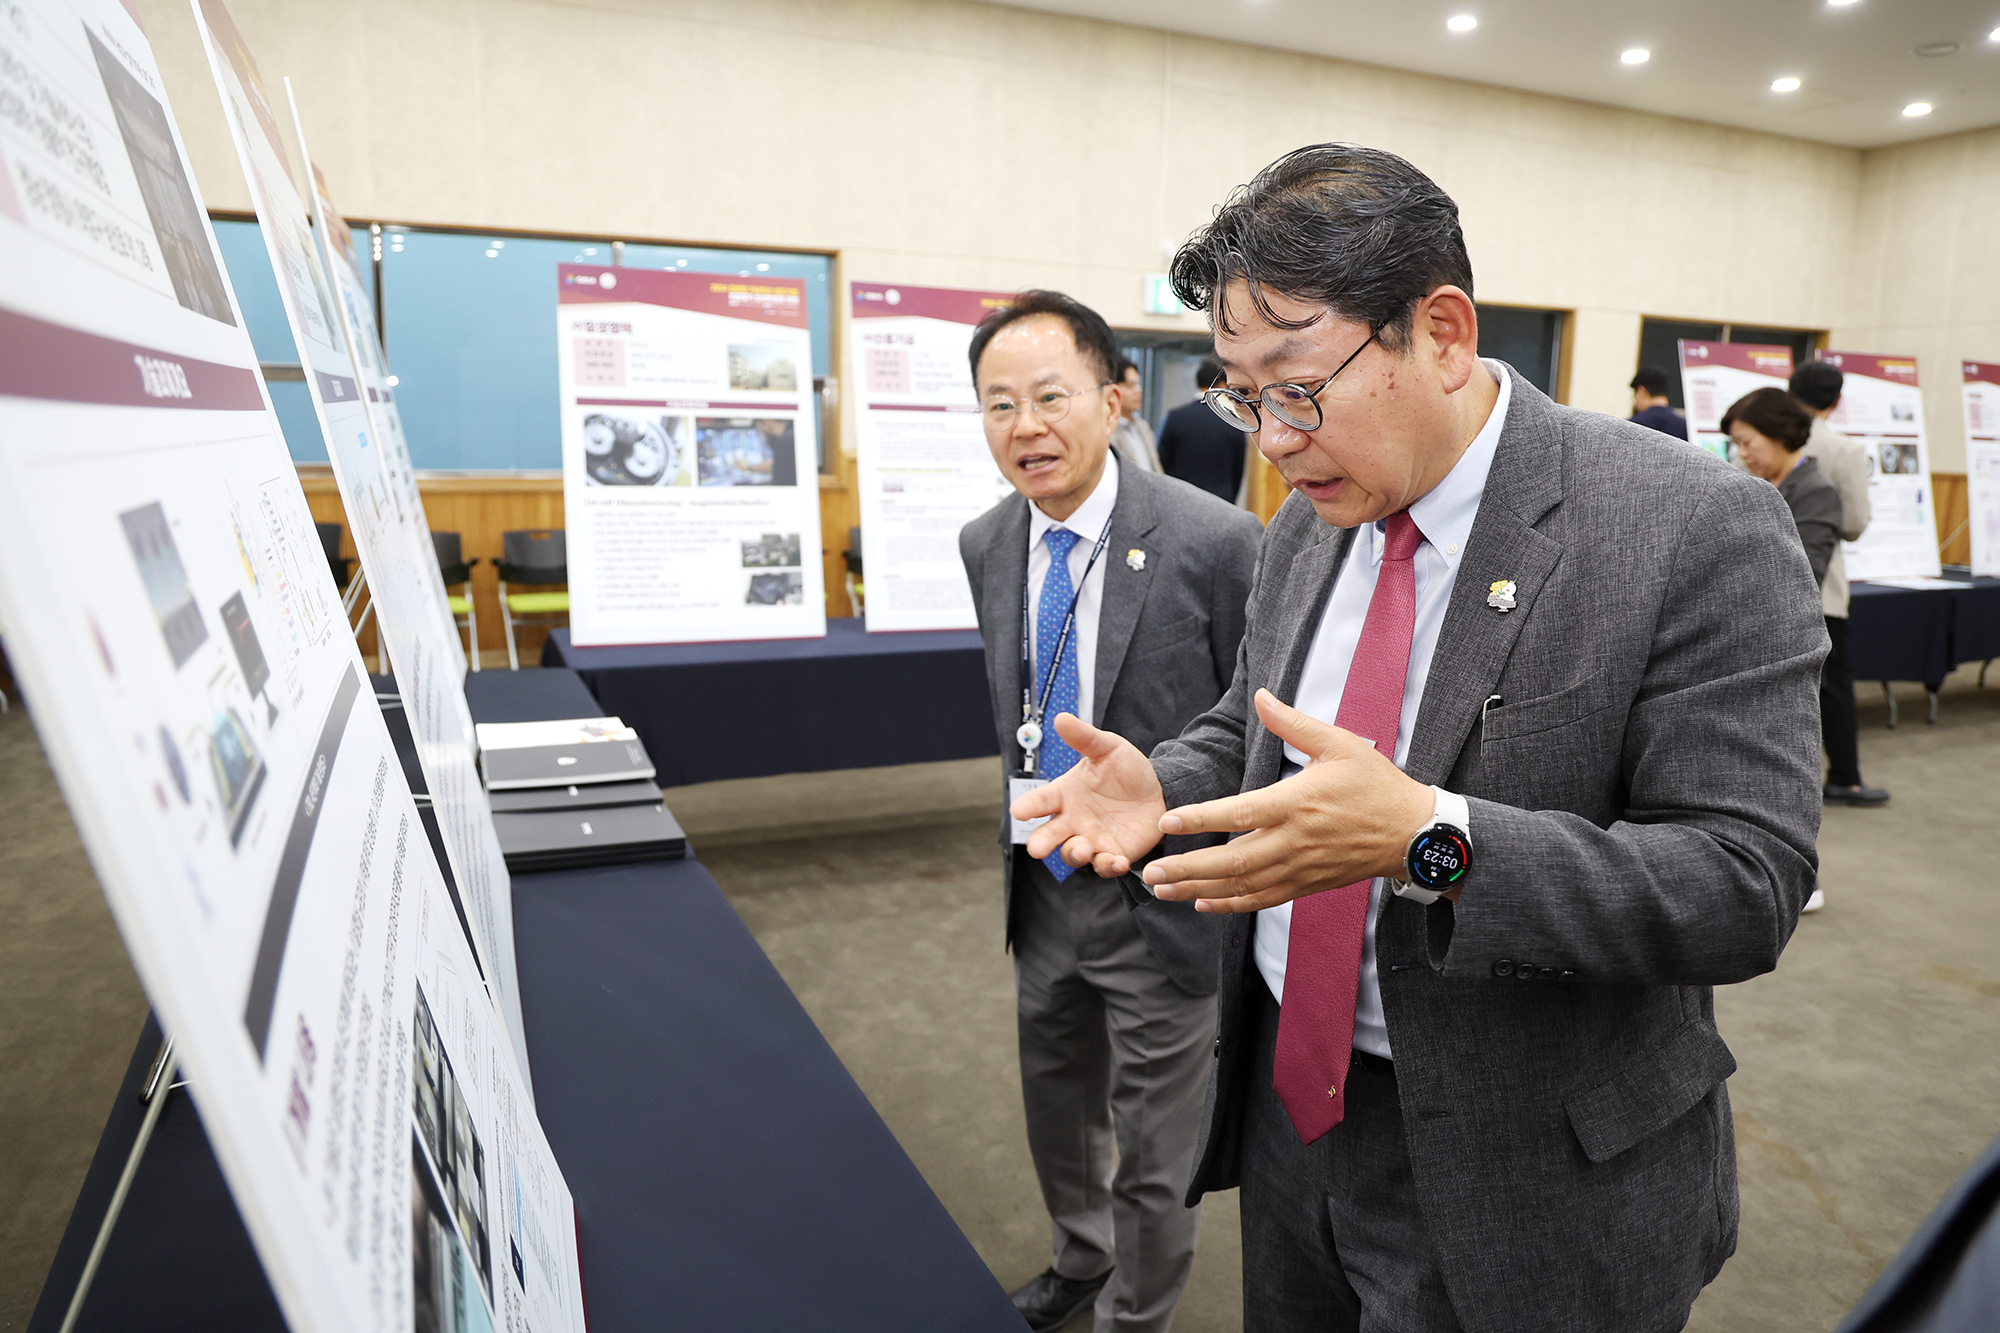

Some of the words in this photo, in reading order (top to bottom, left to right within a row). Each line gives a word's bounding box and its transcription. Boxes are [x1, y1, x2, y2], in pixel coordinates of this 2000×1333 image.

[1054, 634, 1067, 663] promotion
[1062, 613, 1074, 635] Agency
[1423, 849, 1458, 869] 03:23
